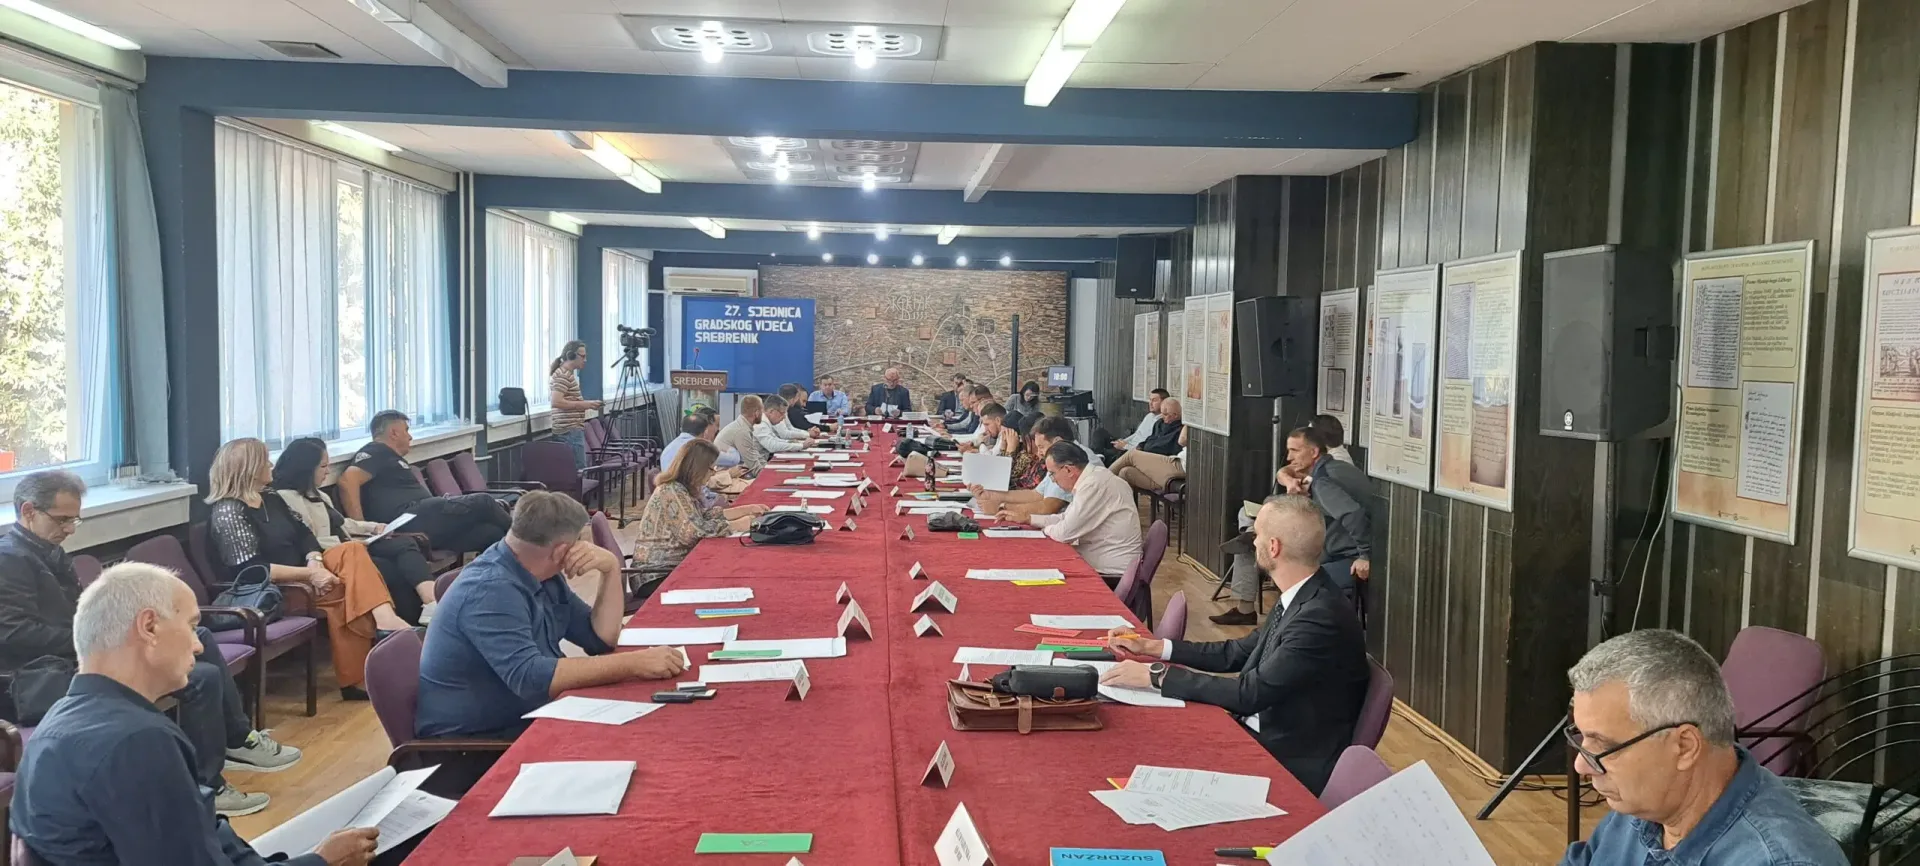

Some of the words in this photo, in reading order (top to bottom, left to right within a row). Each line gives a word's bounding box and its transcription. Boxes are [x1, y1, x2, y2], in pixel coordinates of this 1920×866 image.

[724, 304, 742, 317] 27.
[747, 305, 802, 318] SJEDNICA
[694, 319, 752, 331] GRADSKOG
[754, 319, 794, 332] VIJEĆA
[694, 332, 759, 344] SREBRENIK
[673, 376, 724, 387] SREBRENIK
